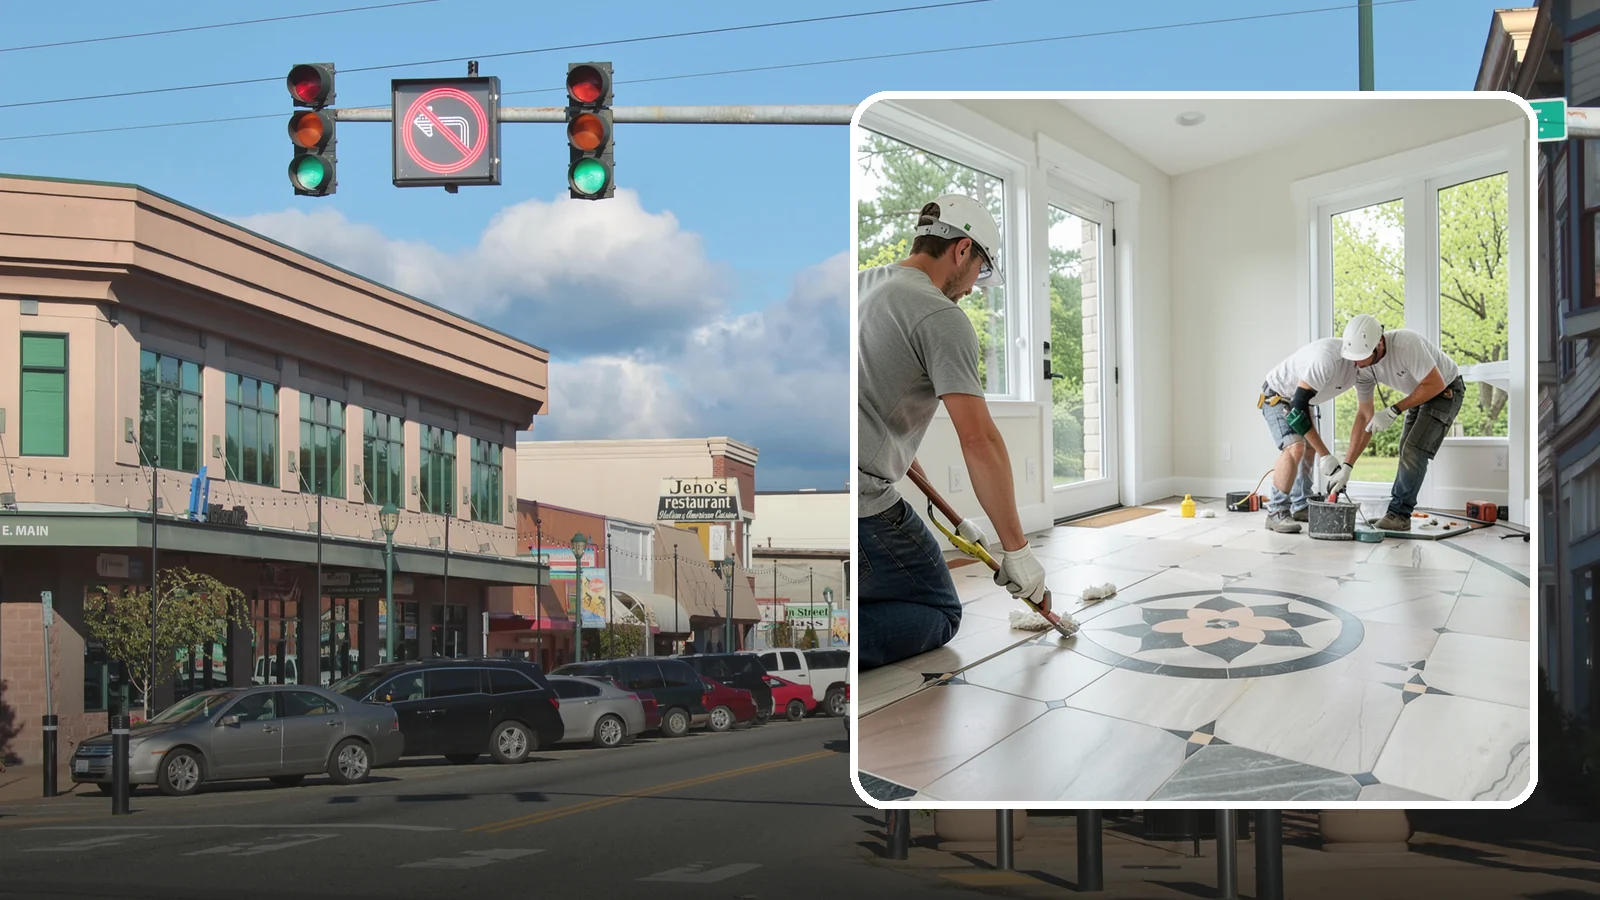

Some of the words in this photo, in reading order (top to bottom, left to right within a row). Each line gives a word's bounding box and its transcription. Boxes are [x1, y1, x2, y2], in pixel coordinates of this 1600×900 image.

[670, 480, 728, 494] Jeno's
[665, 496, 730, 509] restaurant
[658, 510, 682, 519] Italian
[686, 510, 714, 519] American
[715, 510, 737, 519] Cuisine
[2, 525, 12, 536] E.
[16, 525, 48, 536] MAIN
[798, 608, 828, 616] Street
